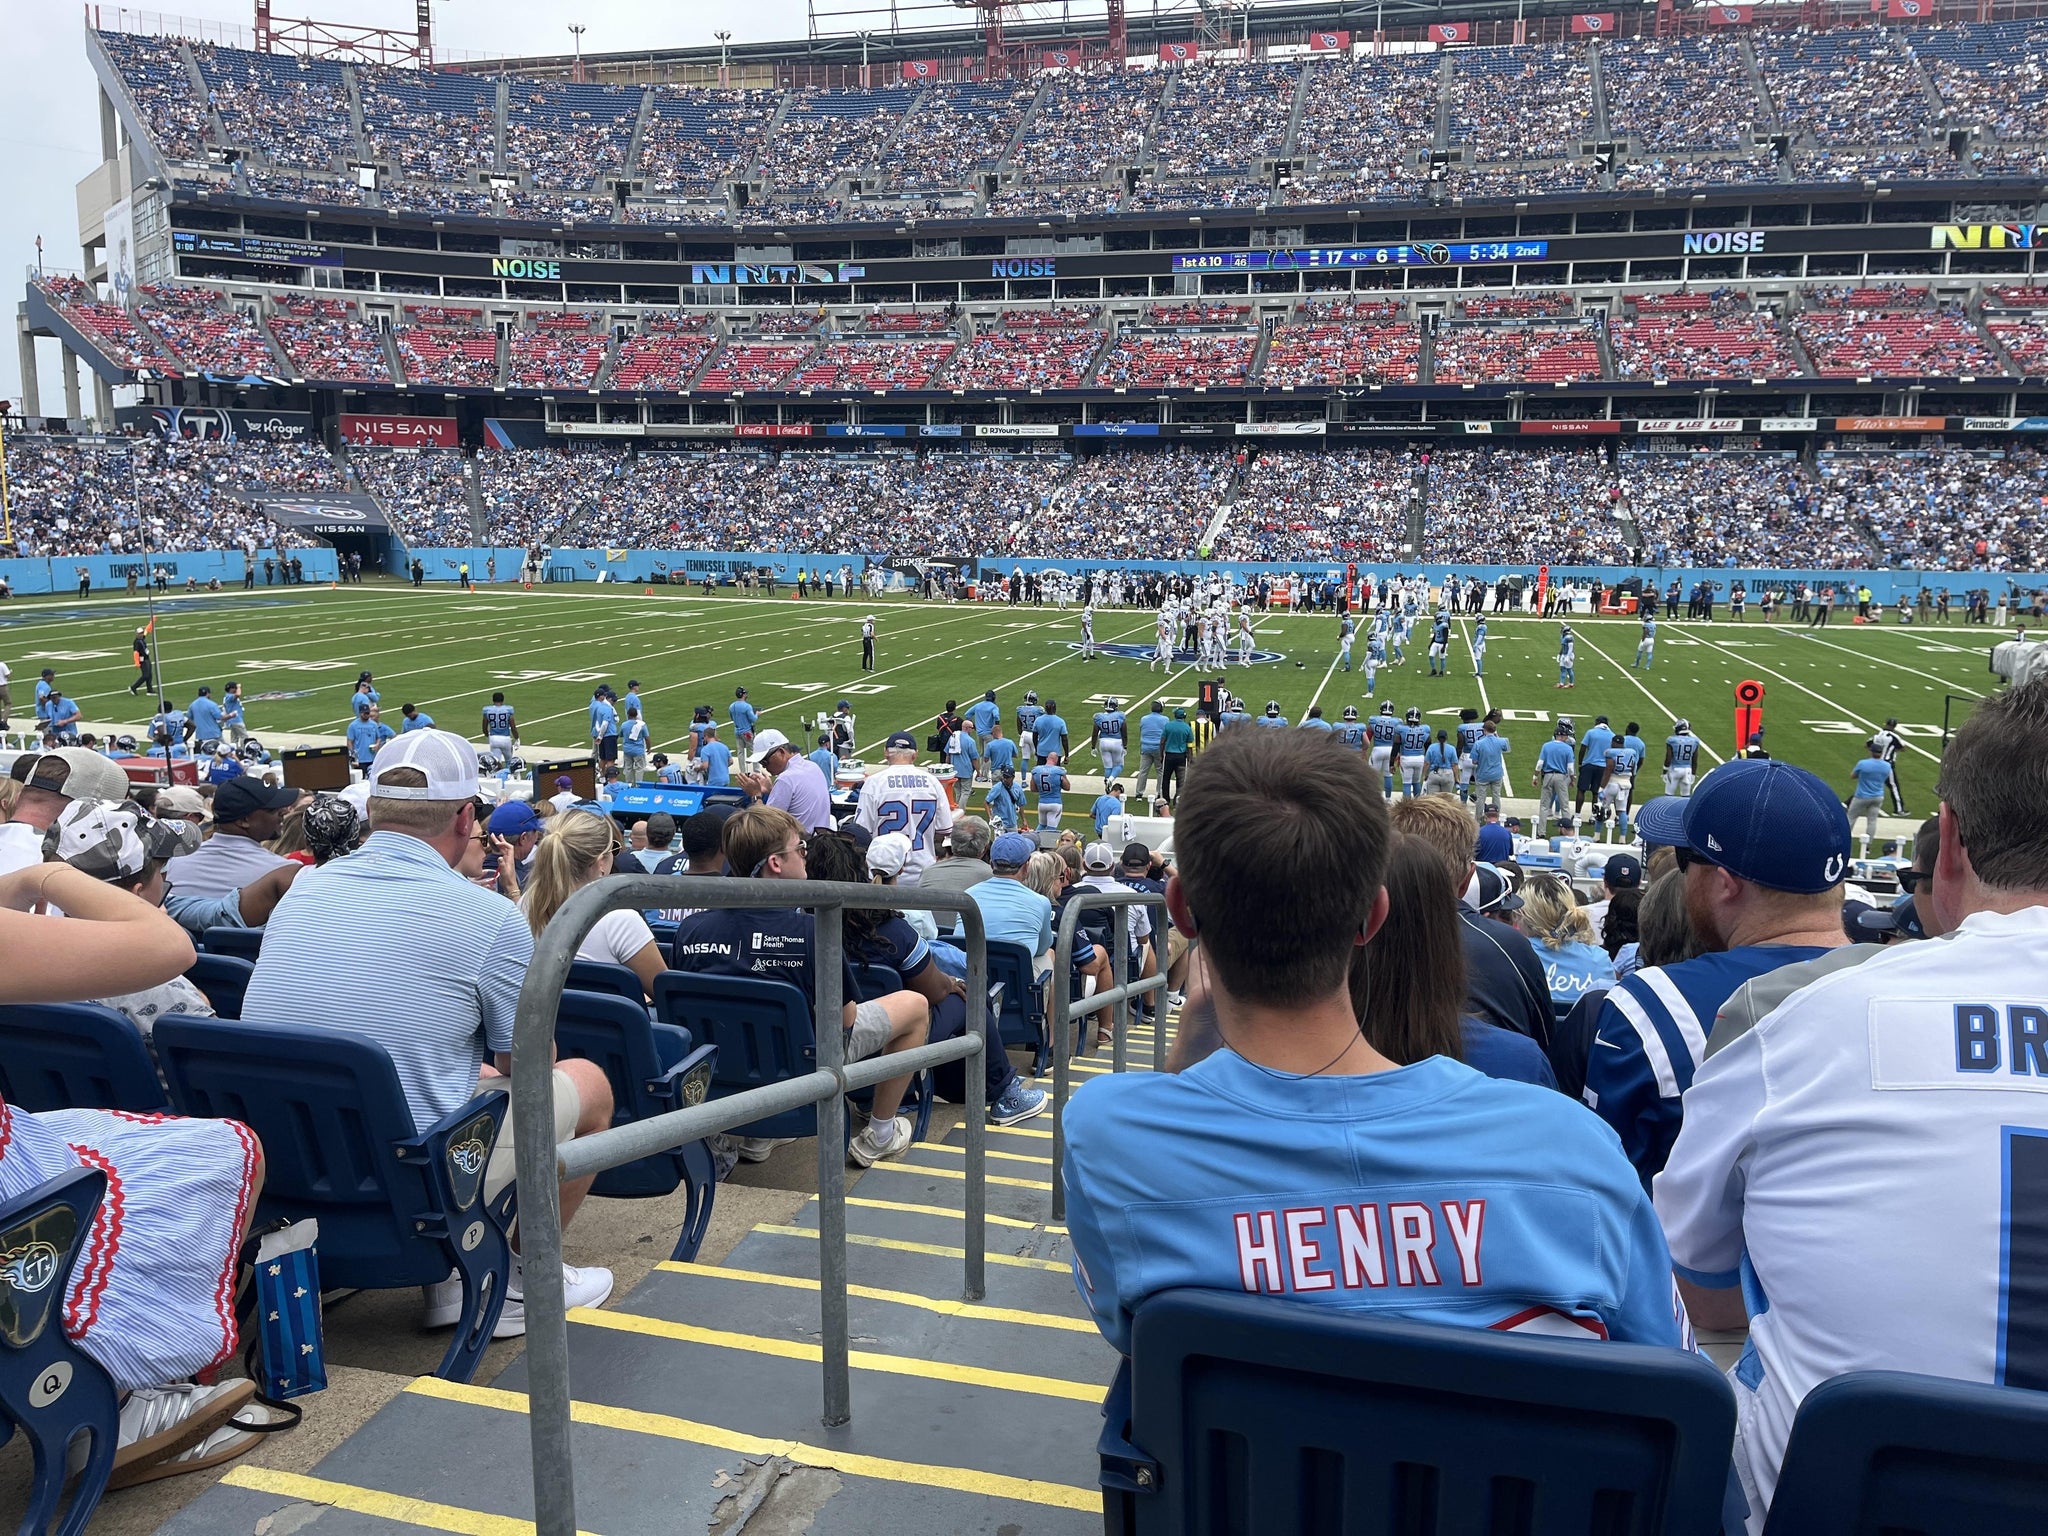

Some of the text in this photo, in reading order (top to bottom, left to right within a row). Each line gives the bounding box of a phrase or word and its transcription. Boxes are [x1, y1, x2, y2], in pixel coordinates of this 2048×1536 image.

[1683, 231, 1766, 254] NOISE
[1326, 250, 1344, 265] 17
[1376, 248, 1388, 263] 6
[1469, 243, 1540, 261] 5:34 2nd
[491, 258, 561, 279] NOISE
[991, 257, 1056, 278] NOISE
[1181, 256, 1222, 267] 1st & 10
[1234, 258, 1247, 267] 46
[263, 417, 305, 440] Kroger
[355, 421, 443, 436] NISSAN
[989, 427, 1020, 435] RJYoung
[1720, 420, 1739, 428] LEE
[1965, 419, 2009, 429] Pinnacle
[314, 524, 365, 534] NISSAN
[685, 559, 726, 573] TENNESSEE
[1203, 684, 1212, 703] 1
[489, 713, 507, 729] 88
[1101, 720, 1120, 734] 90
[1374, 724, 1395, 741] 98
[1404, 733, 1425, 750] 96
[1677, 744, 1692, 761] 18
[210, 761, 229, 771] EMS
[1614, 755, 1635, 773] 54
[887, 775, 930, 789] GEORGE
[1040, 774, 1051, 792] 6
[877, 799, 937, 851] 27
[682, 942, 732, 955] NISSAN
[468, 1228, 479, 1244] P
[1233, 1198, 1486, 1294] HENRY
[42, 1373, 62, 1397] Q
